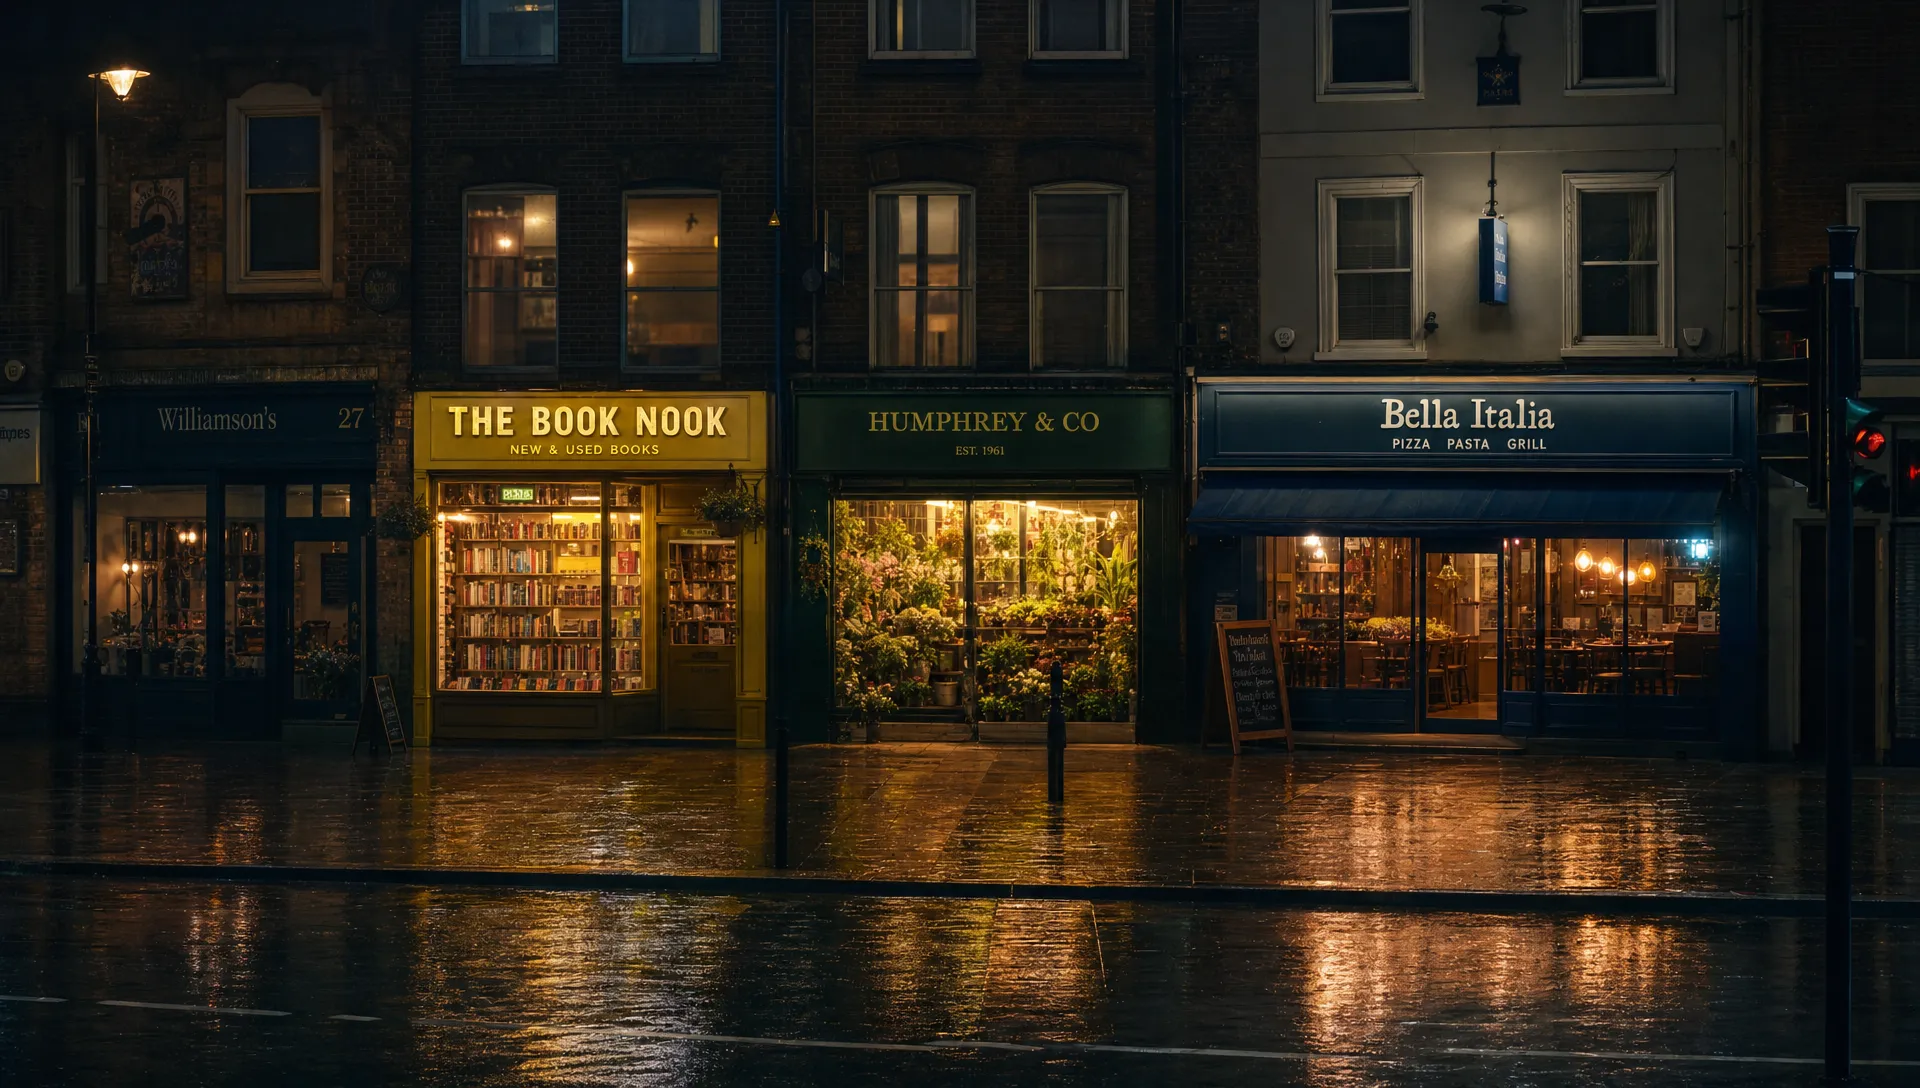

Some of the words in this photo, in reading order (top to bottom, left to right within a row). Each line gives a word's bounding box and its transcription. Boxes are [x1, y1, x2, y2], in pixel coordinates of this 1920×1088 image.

[157, 405, 277, 431] Williamson's
[338, 407, 365, 429] 27
[448, 406, 514, 436] THE
[531, 406, 619, 436] BOOK
[636, 406, 727, 436] NOOK
[868, 411, 1027, 432] HUMPHREY
[1034, 411, 1055, 432] &
[1062, 411, 1100, 432] CO
[1380, 398, 1460, 429] Bella
[1470, 398, 1555, 429] Italia
[510, 444, 542, 455] NEW
[549, 444, 558, 455] &
[566, 444, 603, 455] USED
[610, 444, 659, 455] BOOKS
[955, 446, 979, 456] EST.
[982, 446, 1005, 456] 1961
[1392, 438, 1431, 450] PIZZA
[1447, 438, 1490, 450] PASTA
[1507, 438, 1547, 450] GRILL
